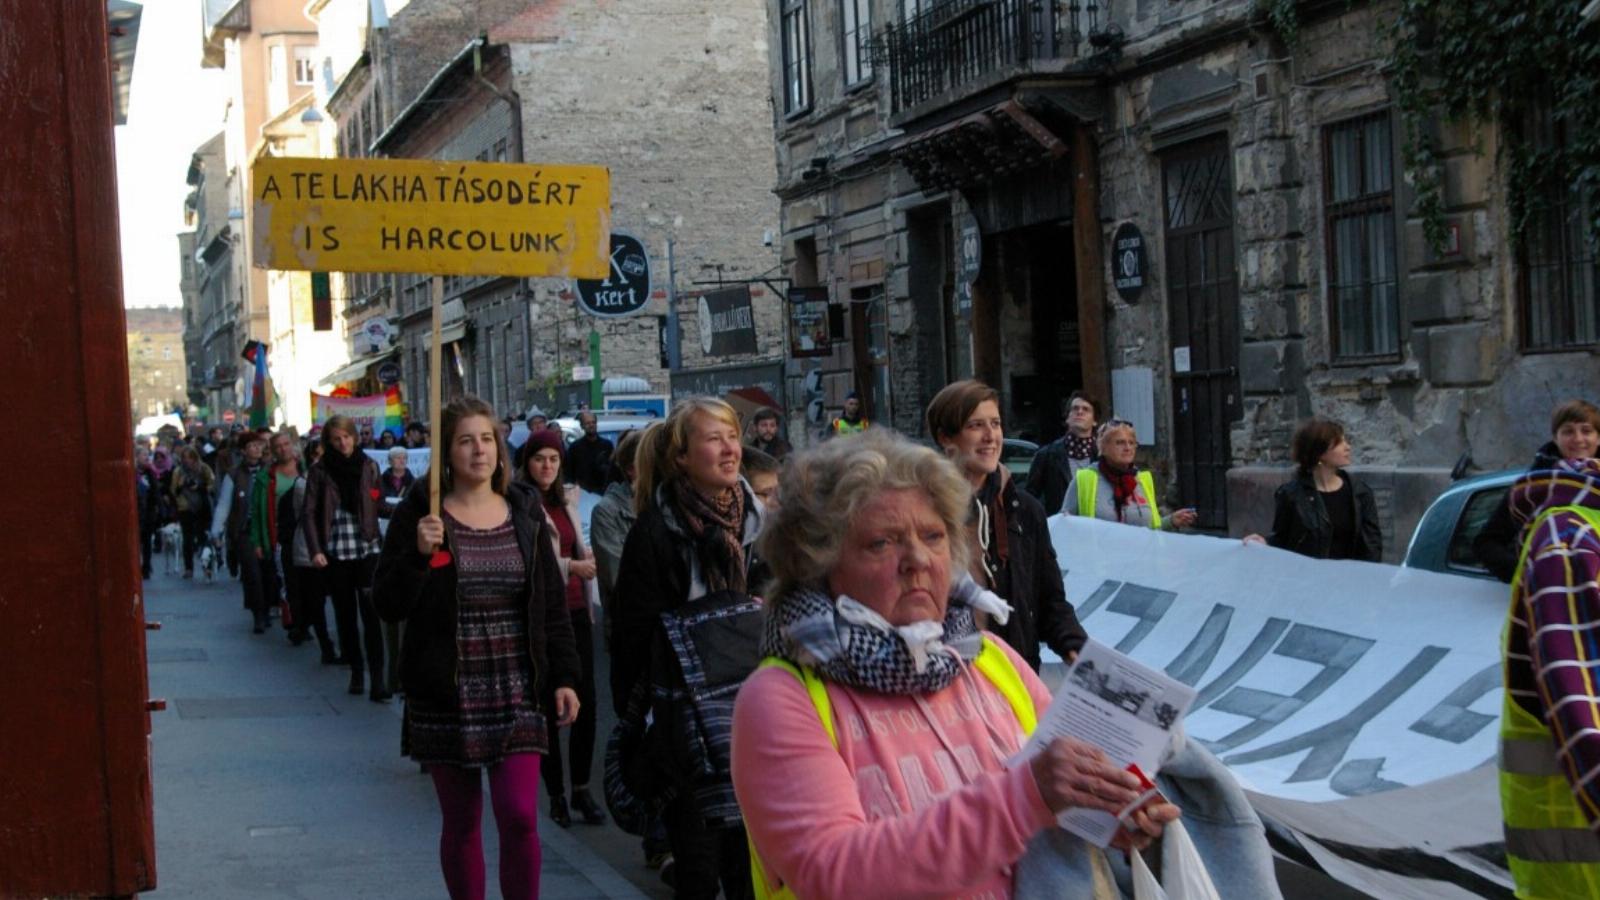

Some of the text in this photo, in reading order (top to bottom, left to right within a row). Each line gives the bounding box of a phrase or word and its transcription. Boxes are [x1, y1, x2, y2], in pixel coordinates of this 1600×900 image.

[260, 174, 282, 201] A
[304, 224, 564, 253] IS HARCOLUNK
